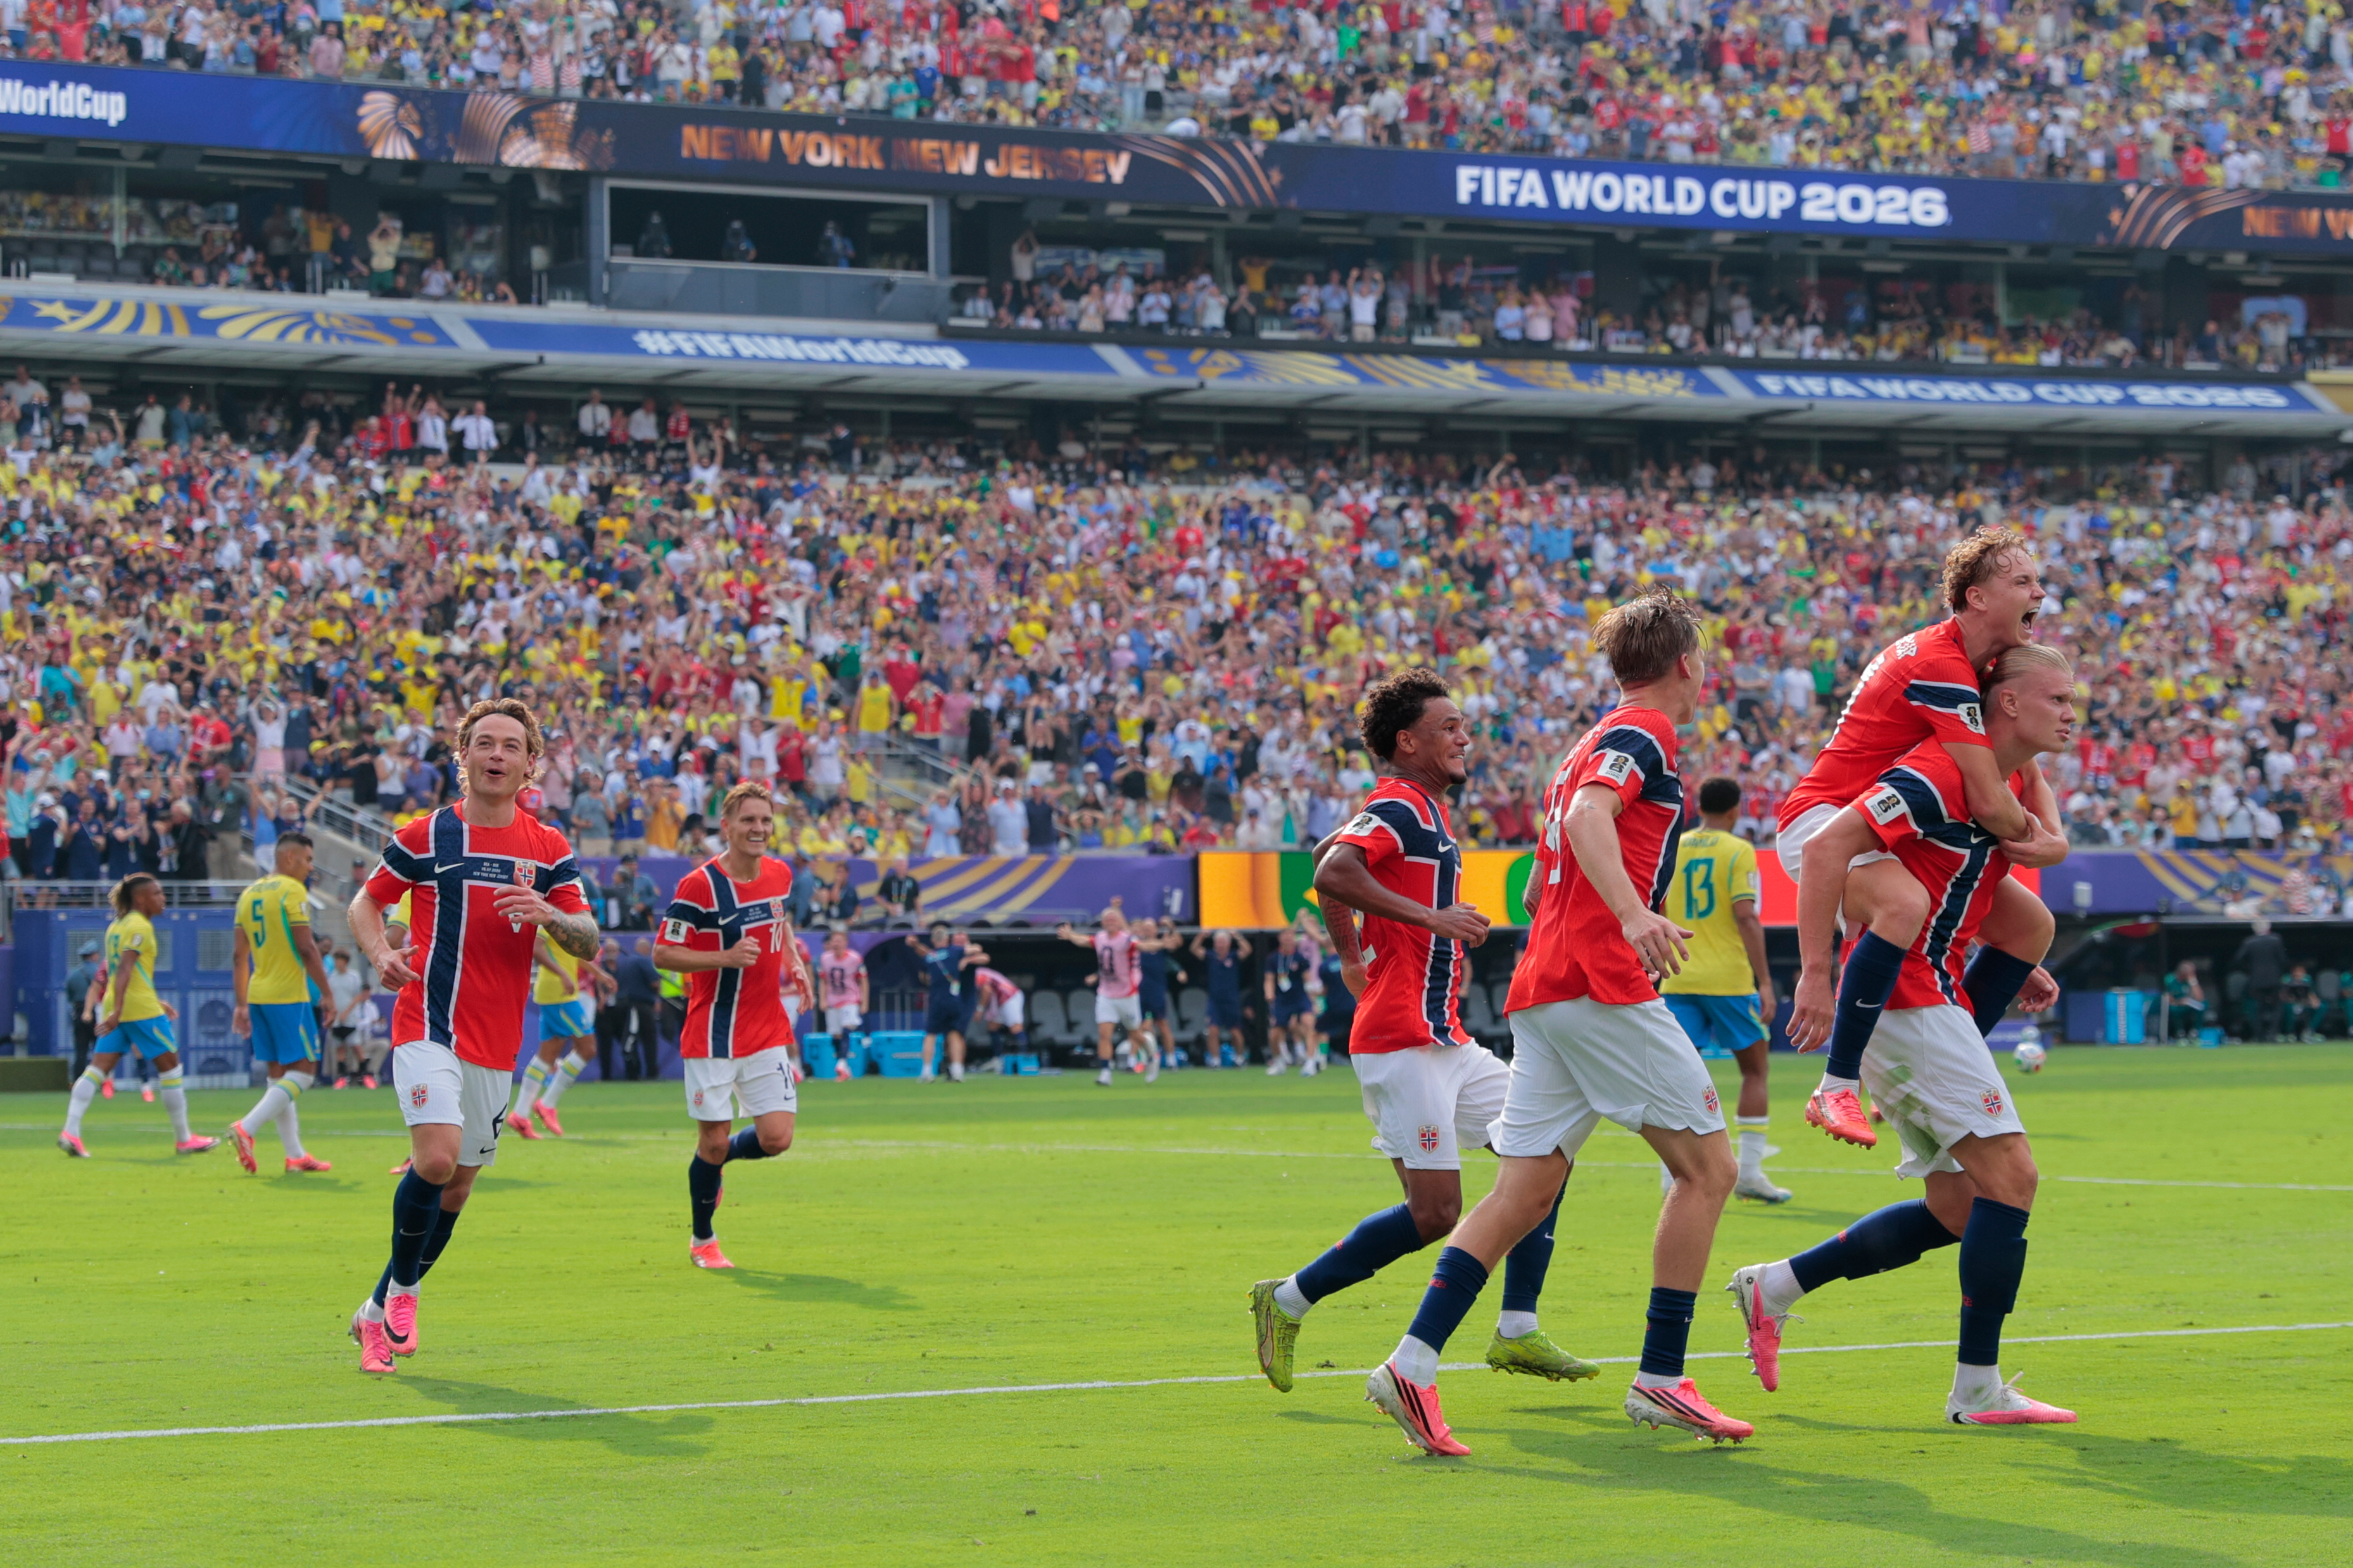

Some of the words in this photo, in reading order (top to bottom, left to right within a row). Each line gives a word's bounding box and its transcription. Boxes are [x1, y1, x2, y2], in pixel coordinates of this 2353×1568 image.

[0, 78, 127, 127] WorldCup
[681, 123, 773, 163] NEW
[778, 129, 885, 170] YORK
[891, 137, 980, 176] NEW
[984, 143, 1132, 185] JERSEY
[1456, 165, 1549, 208] FIFA
[1551, 170, 1706, 216] WORLD
[1710, 178, 1796, 220] CUP
[1800, 182, 1949, 227] 2026
[2242, 205, 2322, 239] NEW
[633, 329, 970, 371] #FIFAWorldCup
[1755, 374, 1870, 398] FIFA
[1858, 378, 2033, 403] WORLD
[2033, 382, 2126, 405] CUP
[2126, 384, 2290, 408] 2026
[1682, 857, 1716, 920] 13
[251, 899, 265, 948] 5
[769, 922, 784, 954] 10
